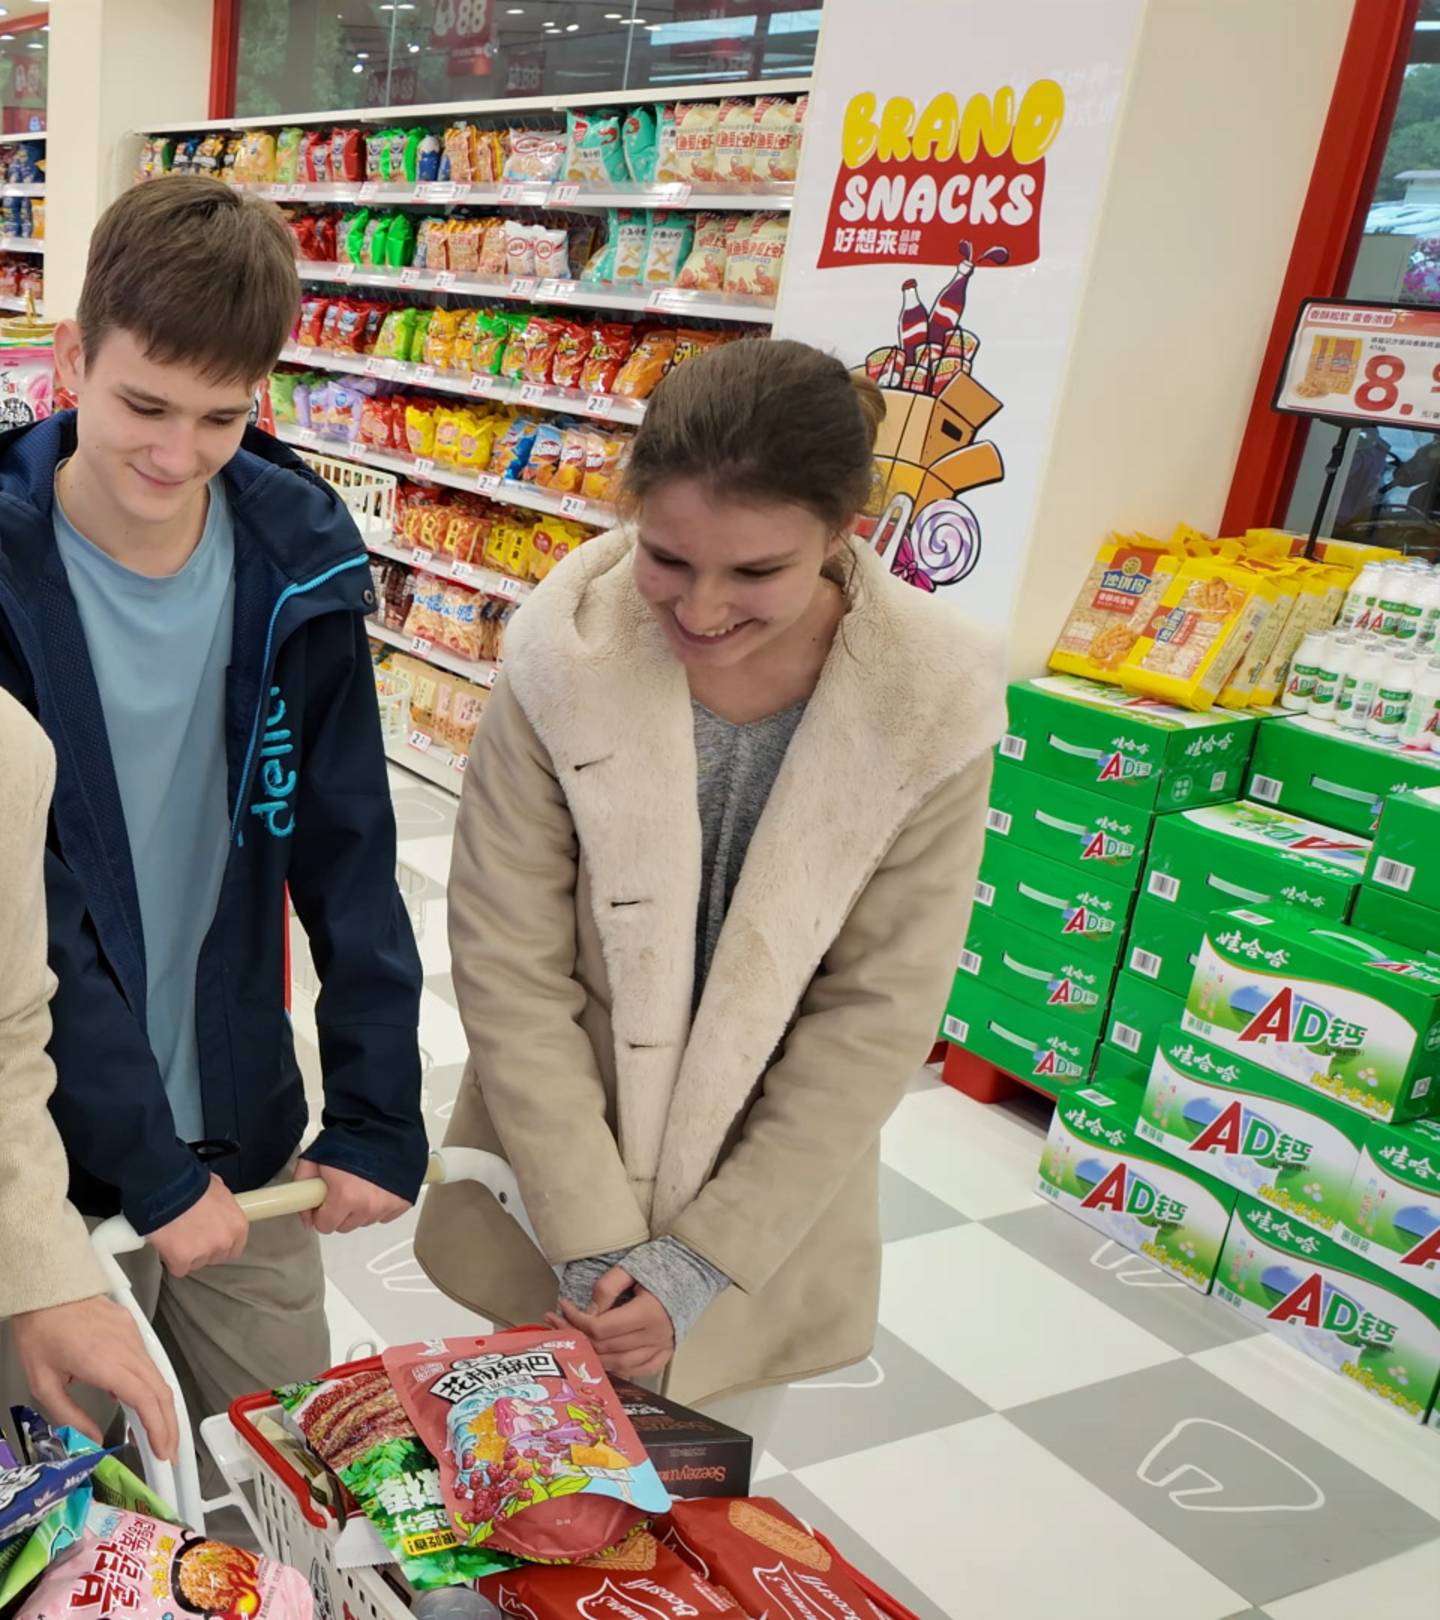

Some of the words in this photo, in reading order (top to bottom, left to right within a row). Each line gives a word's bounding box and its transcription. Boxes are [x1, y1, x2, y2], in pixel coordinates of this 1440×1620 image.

[842, 79, 1064, 168] BRAND
[839, 174, 1036, 225] SNACKS
[833, 228, 899, 254] 好想来
[1185, 732, 1235, 757] 娃哈哈
[1216, 930, 1290, 968] 娃哈哈
[1238, 986, 1367, 1047] AD钙
[1169, 1044, 1240, 1083] 娃哈哈
[1065, 1108, 1126, 1146] 娃哈哈
[1188, 1100, 1313, 1162] AD钙
[1379, 1145, 1440, 1180] 娃哈
[1080, 1162, 1188, 1222] AD钙
[1247, 1209, 1320, 1252] 娃哈哈
[1267, 1272, 1398, 1344] AD钙
[69, 1541, 146, 1615] 불닭
